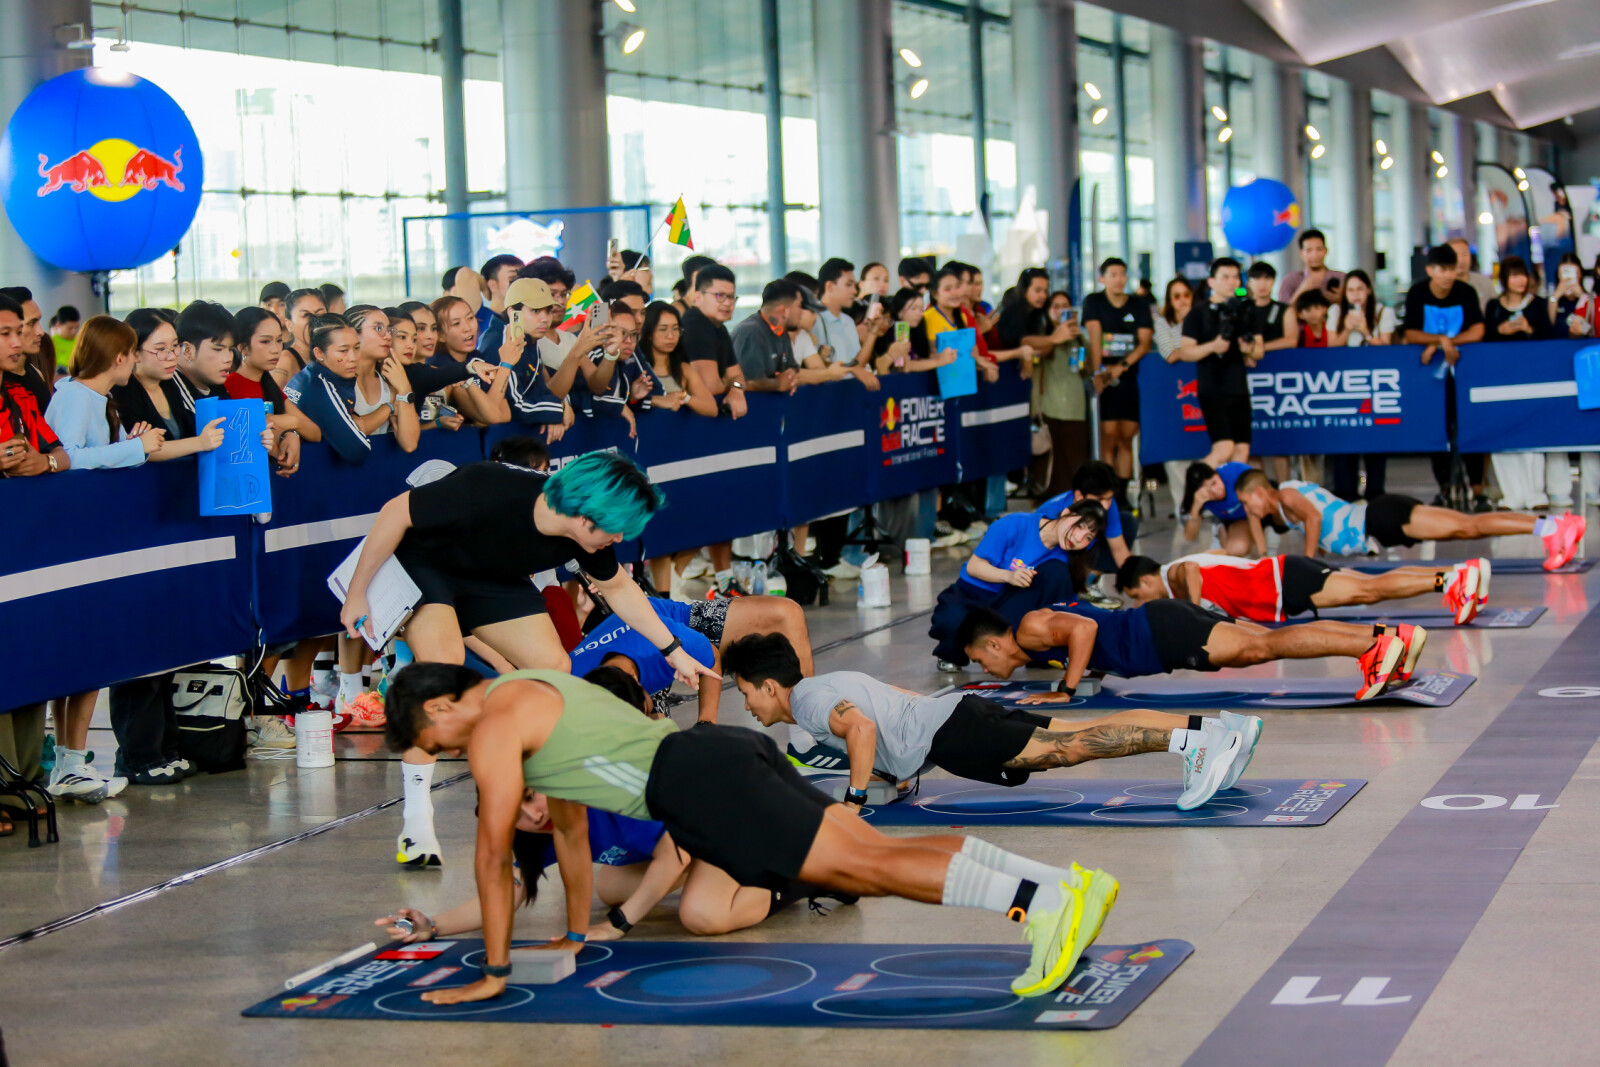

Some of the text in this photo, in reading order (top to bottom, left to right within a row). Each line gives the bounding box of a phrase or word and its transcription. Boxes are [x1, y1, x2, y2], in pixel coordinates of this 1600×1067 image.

[1247, 369, 1400, 393] POWER
[901, 397, 945, 422] POWER
[1182, 404, 1204, 420] Re
[1250, 392, 1402, 416] RACE
[229, 408, 253, 464] 1
[901, 420, 945, 447] RACE
[1251, 418, 1317, 430] national
[1195, 747, 1207, 774] HOKA
[1296, 789, 1338, 813] POWER
[1420, 794, 1560, 810] 10
[308, 959, 391, 994] POWER
[1086, 964, 1149, 1005] POWER
